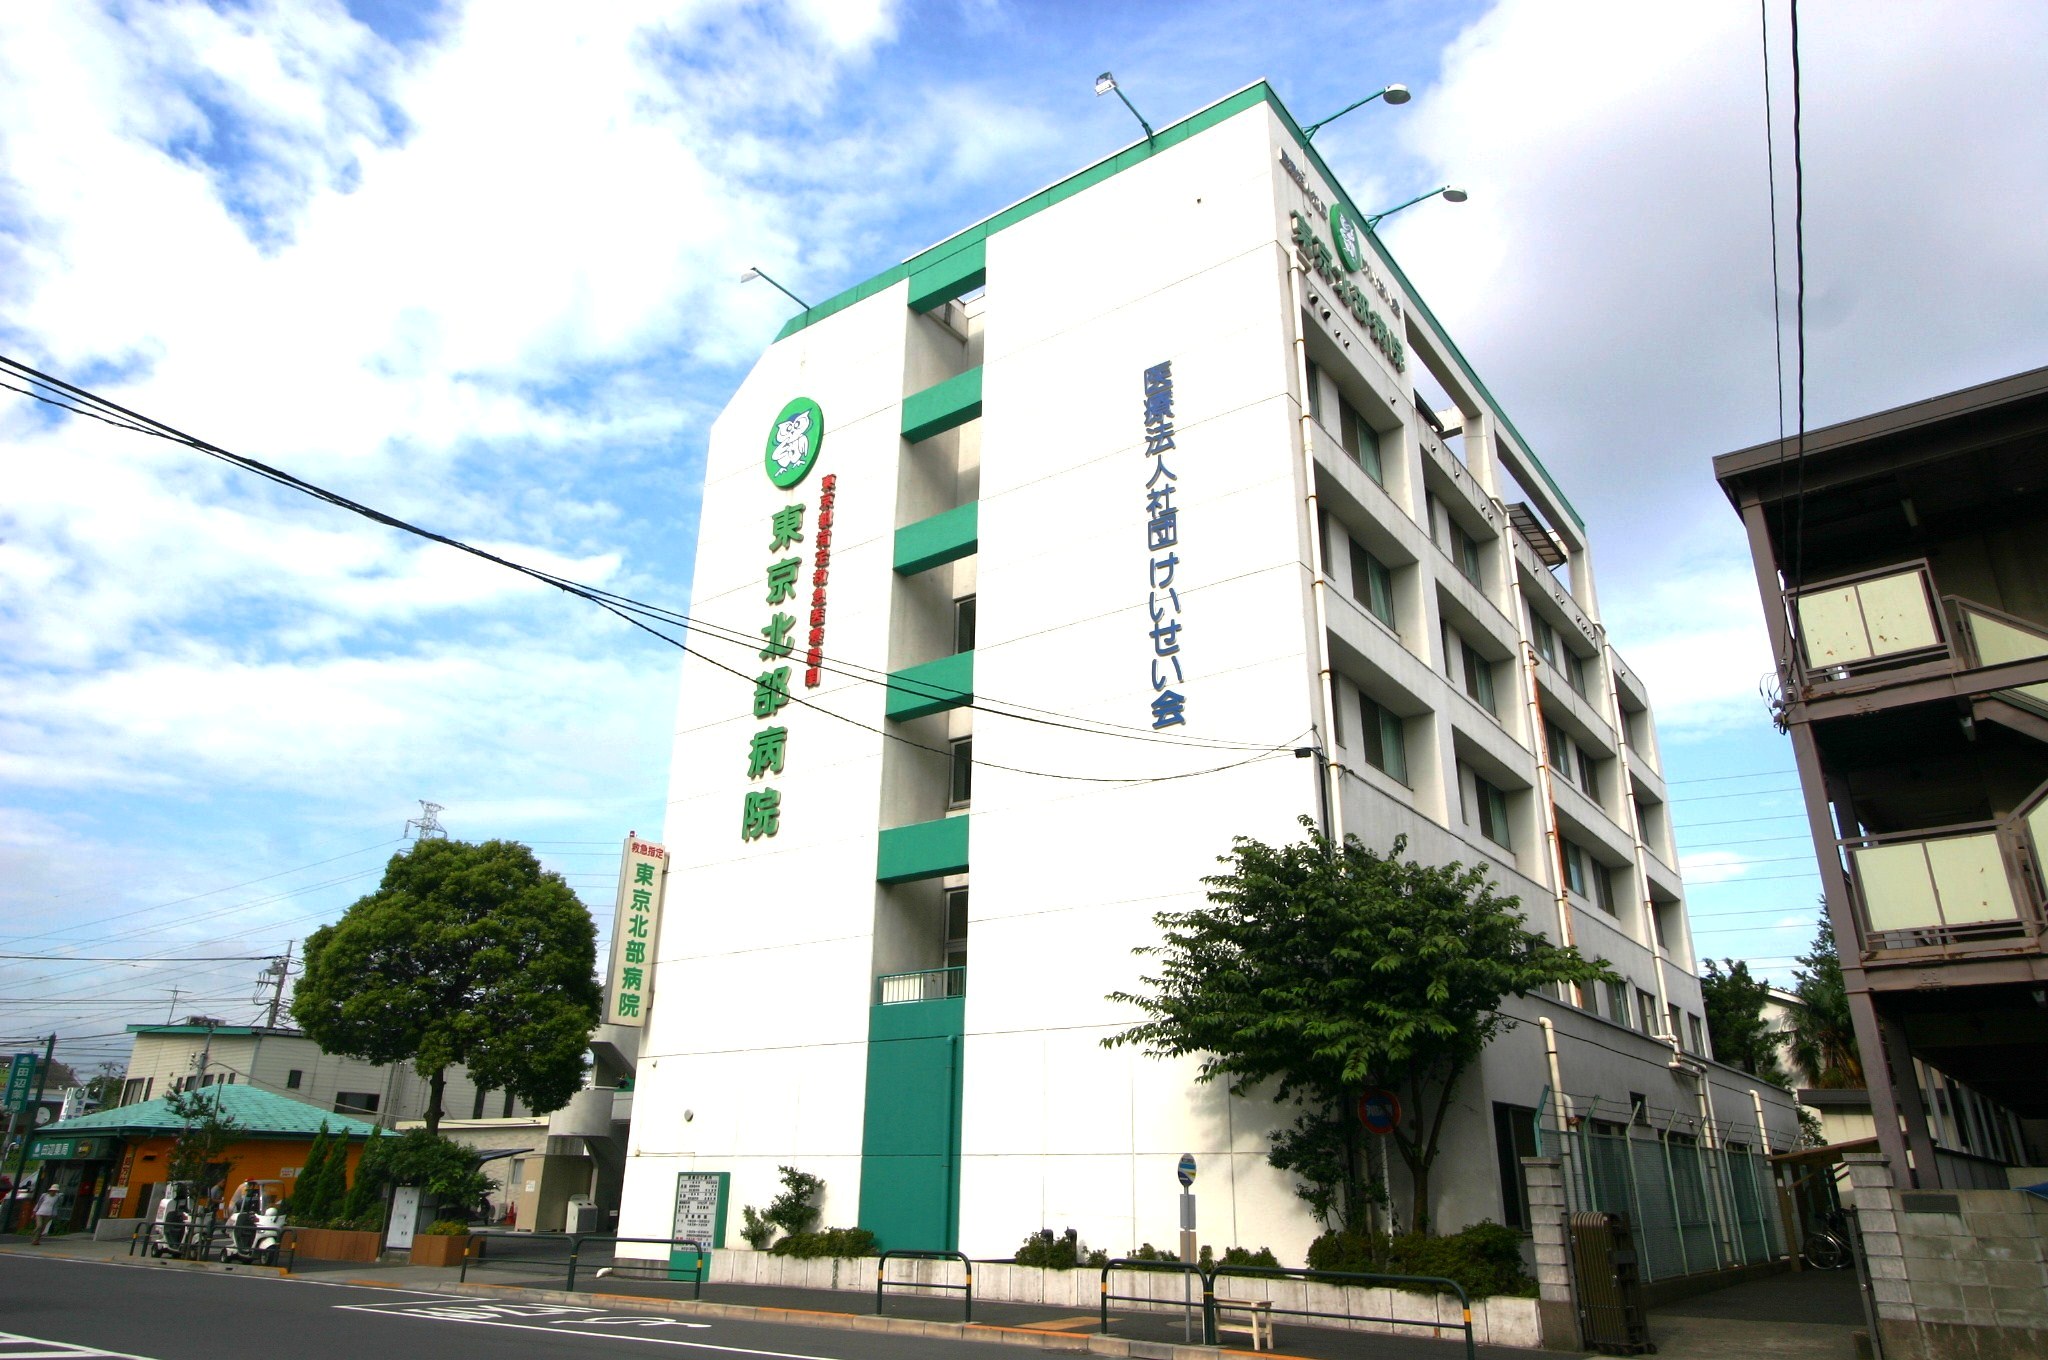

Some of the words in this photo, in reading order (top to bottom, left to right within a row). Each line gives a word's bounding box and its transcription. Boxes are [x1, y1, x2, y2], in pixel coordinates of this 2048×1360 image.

[1144, 360, 1185, 729] 医療法人社団けいせい会
[742, 504, 804, 841] 東京北部病院
[618, 862, 655, 1018] 東京北部病院
[631, 842, 664, 859] 救急指定
